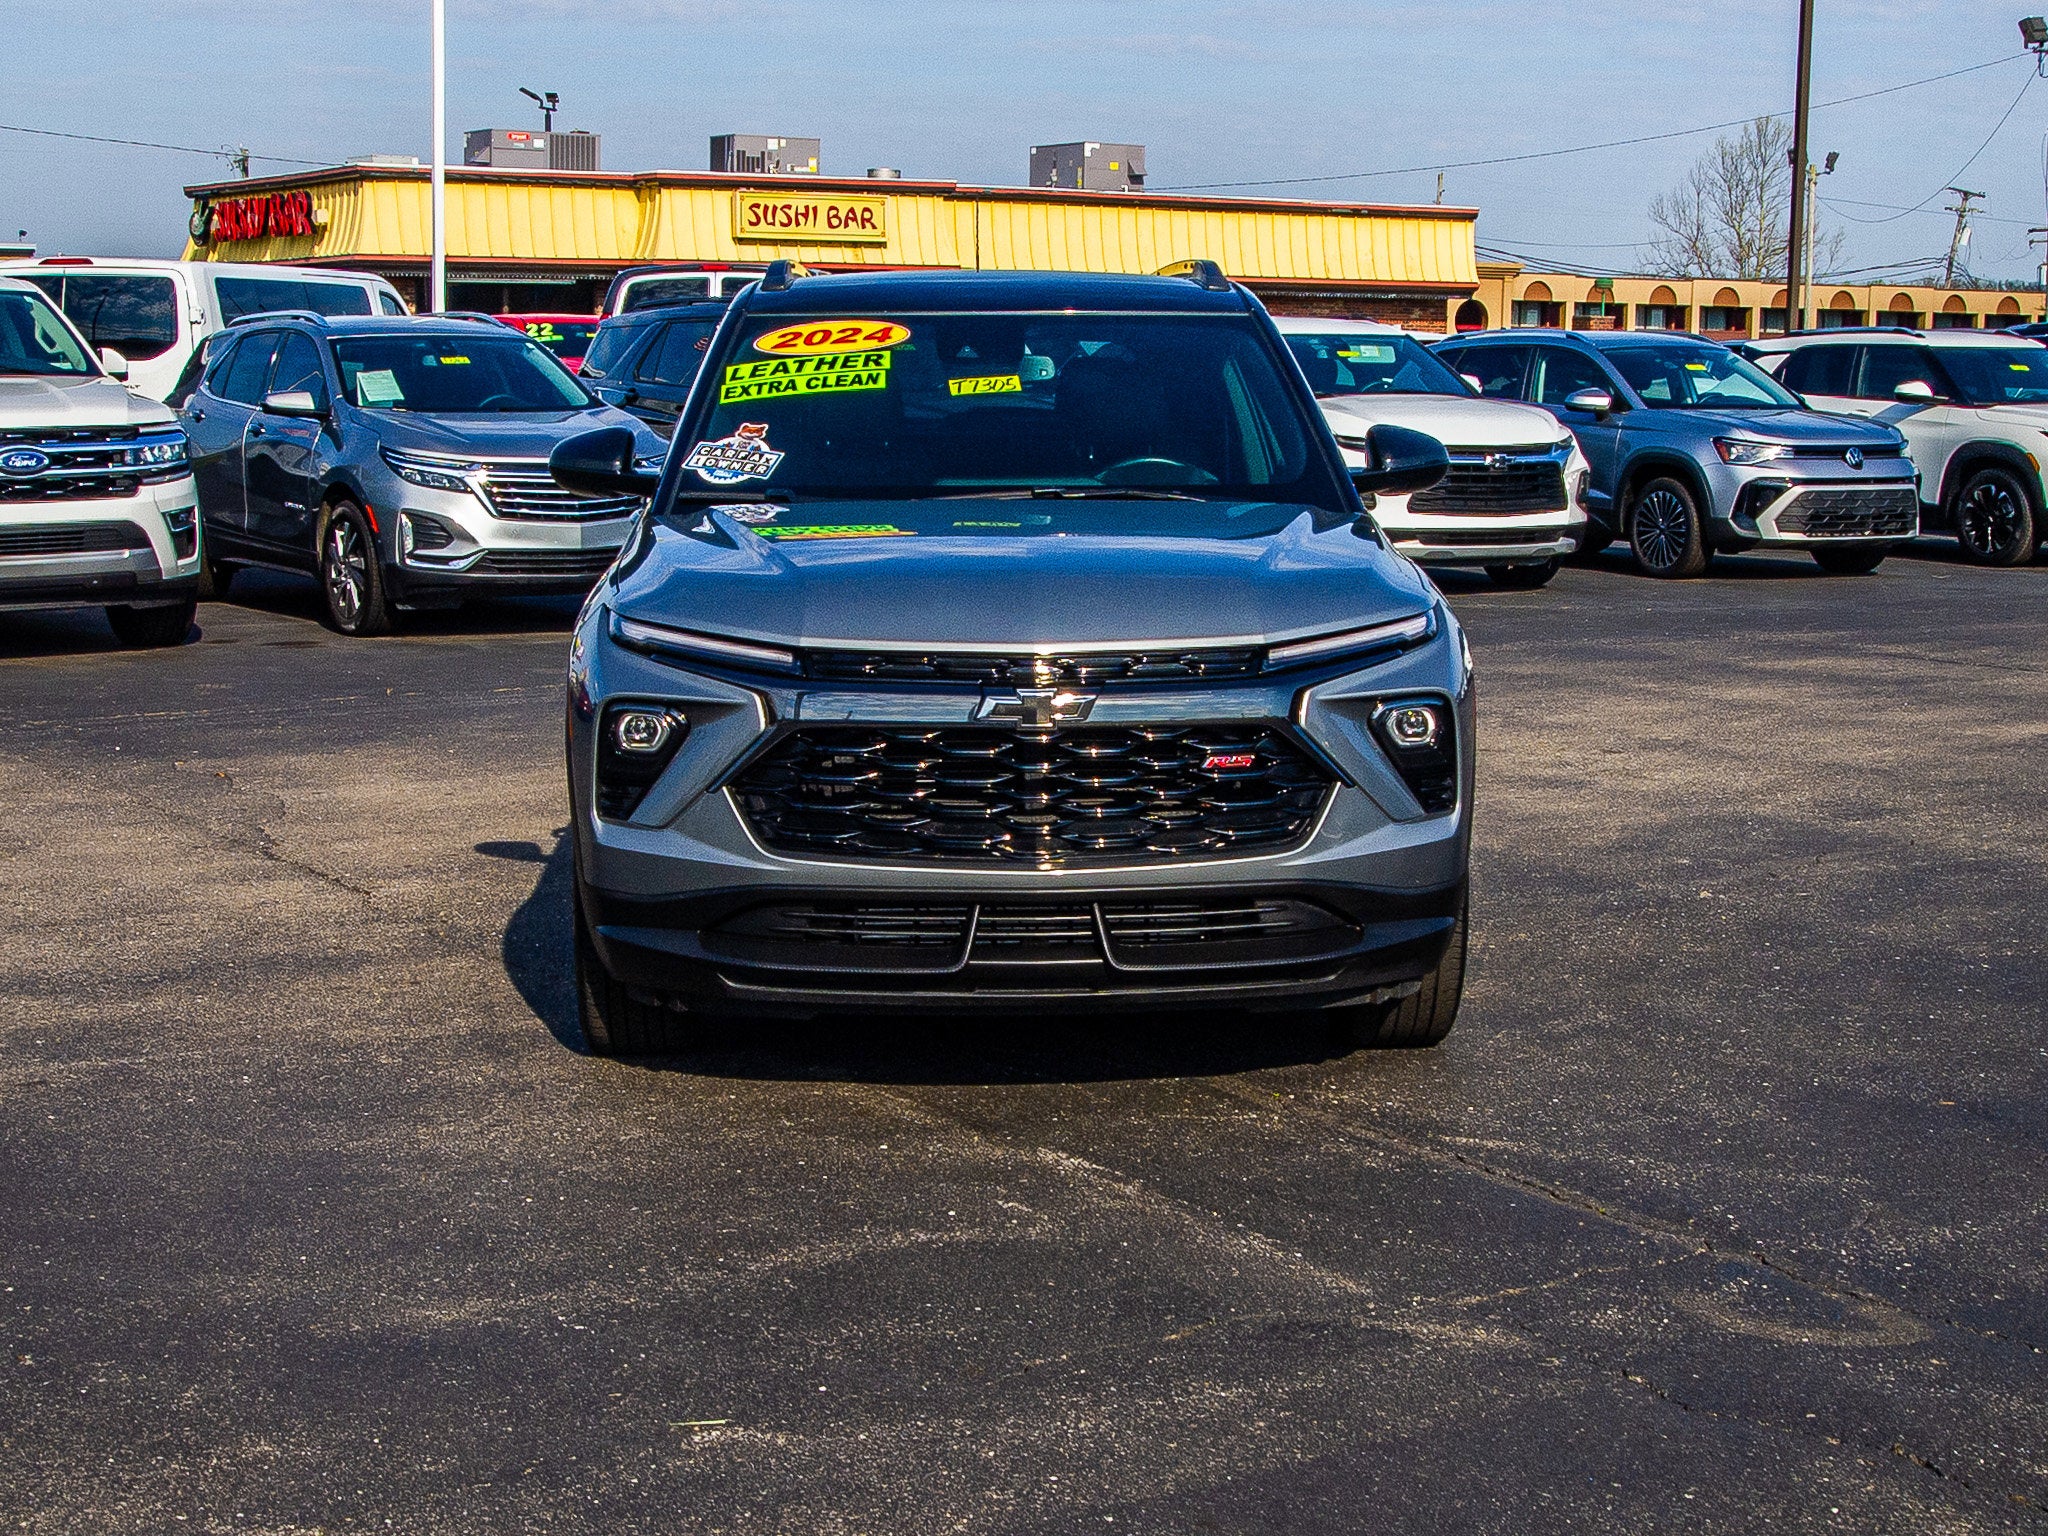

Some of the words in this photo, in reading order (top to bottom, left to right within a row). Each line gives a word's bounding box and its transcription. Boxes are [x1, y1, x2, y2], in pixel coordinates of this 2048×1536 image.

[269, 190, 312, 238] BAR
[748, 202, 818, 228] SUSHI
[826, 205, 877, 230] BAR
[770, 326, 894, 350] 2024
[729, 353, 886, 382] LEATHER
[724, 380, 798, 400] EXTRA
[805, 372, 881, 390] CLEAN
[8, 455, 37, 467] Ford
[700, 446, 777, 465] CARFAX
[705, 458, 768, 474] OWNER
[1202, 755, 1255, 768] RS
